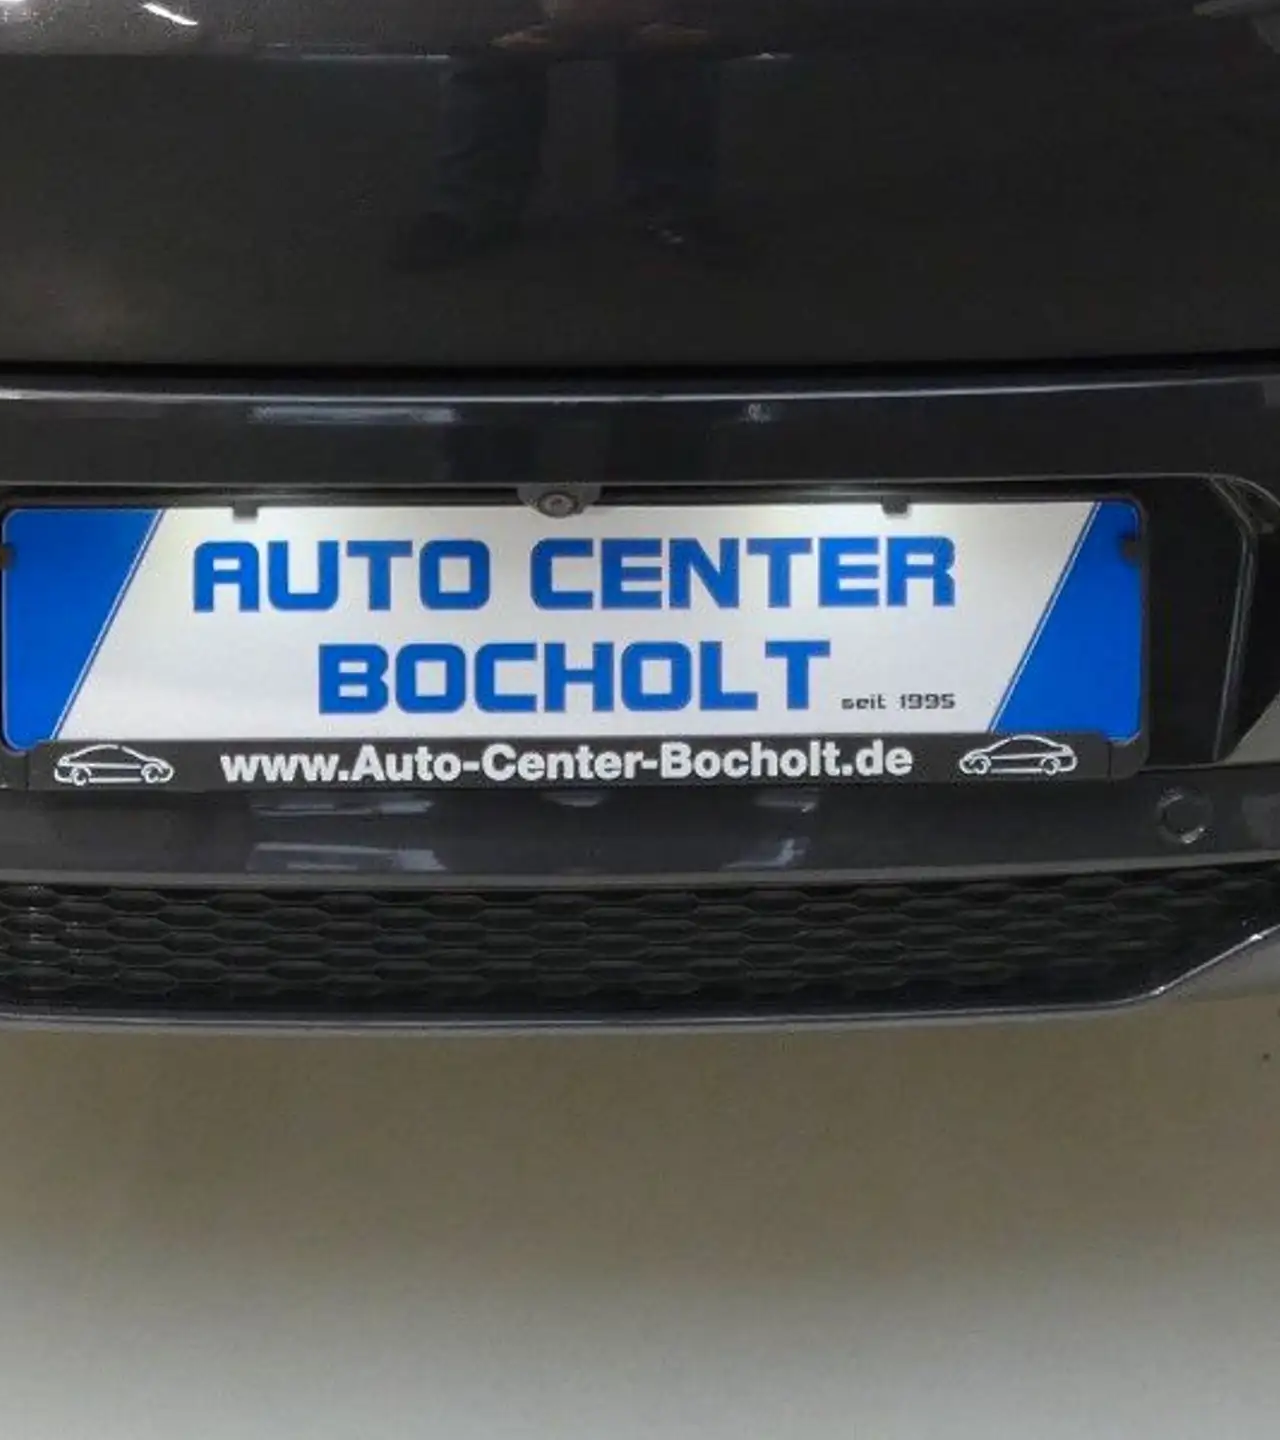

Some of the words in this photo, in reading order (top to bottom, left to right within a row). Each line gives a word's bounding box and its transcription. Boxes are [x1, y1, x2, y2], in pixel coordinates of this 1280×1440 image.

[193, 539, 491, 613] AUTO
[530, 536, 957, 610] CENTER
[317, 640, 831, 715] BOCHOLT
[841, 693, 887, 710] seit
[899, 693, 956, 710] 1995
[219, 738, 914, 783] www.Auto-Center-Bocholt.de
